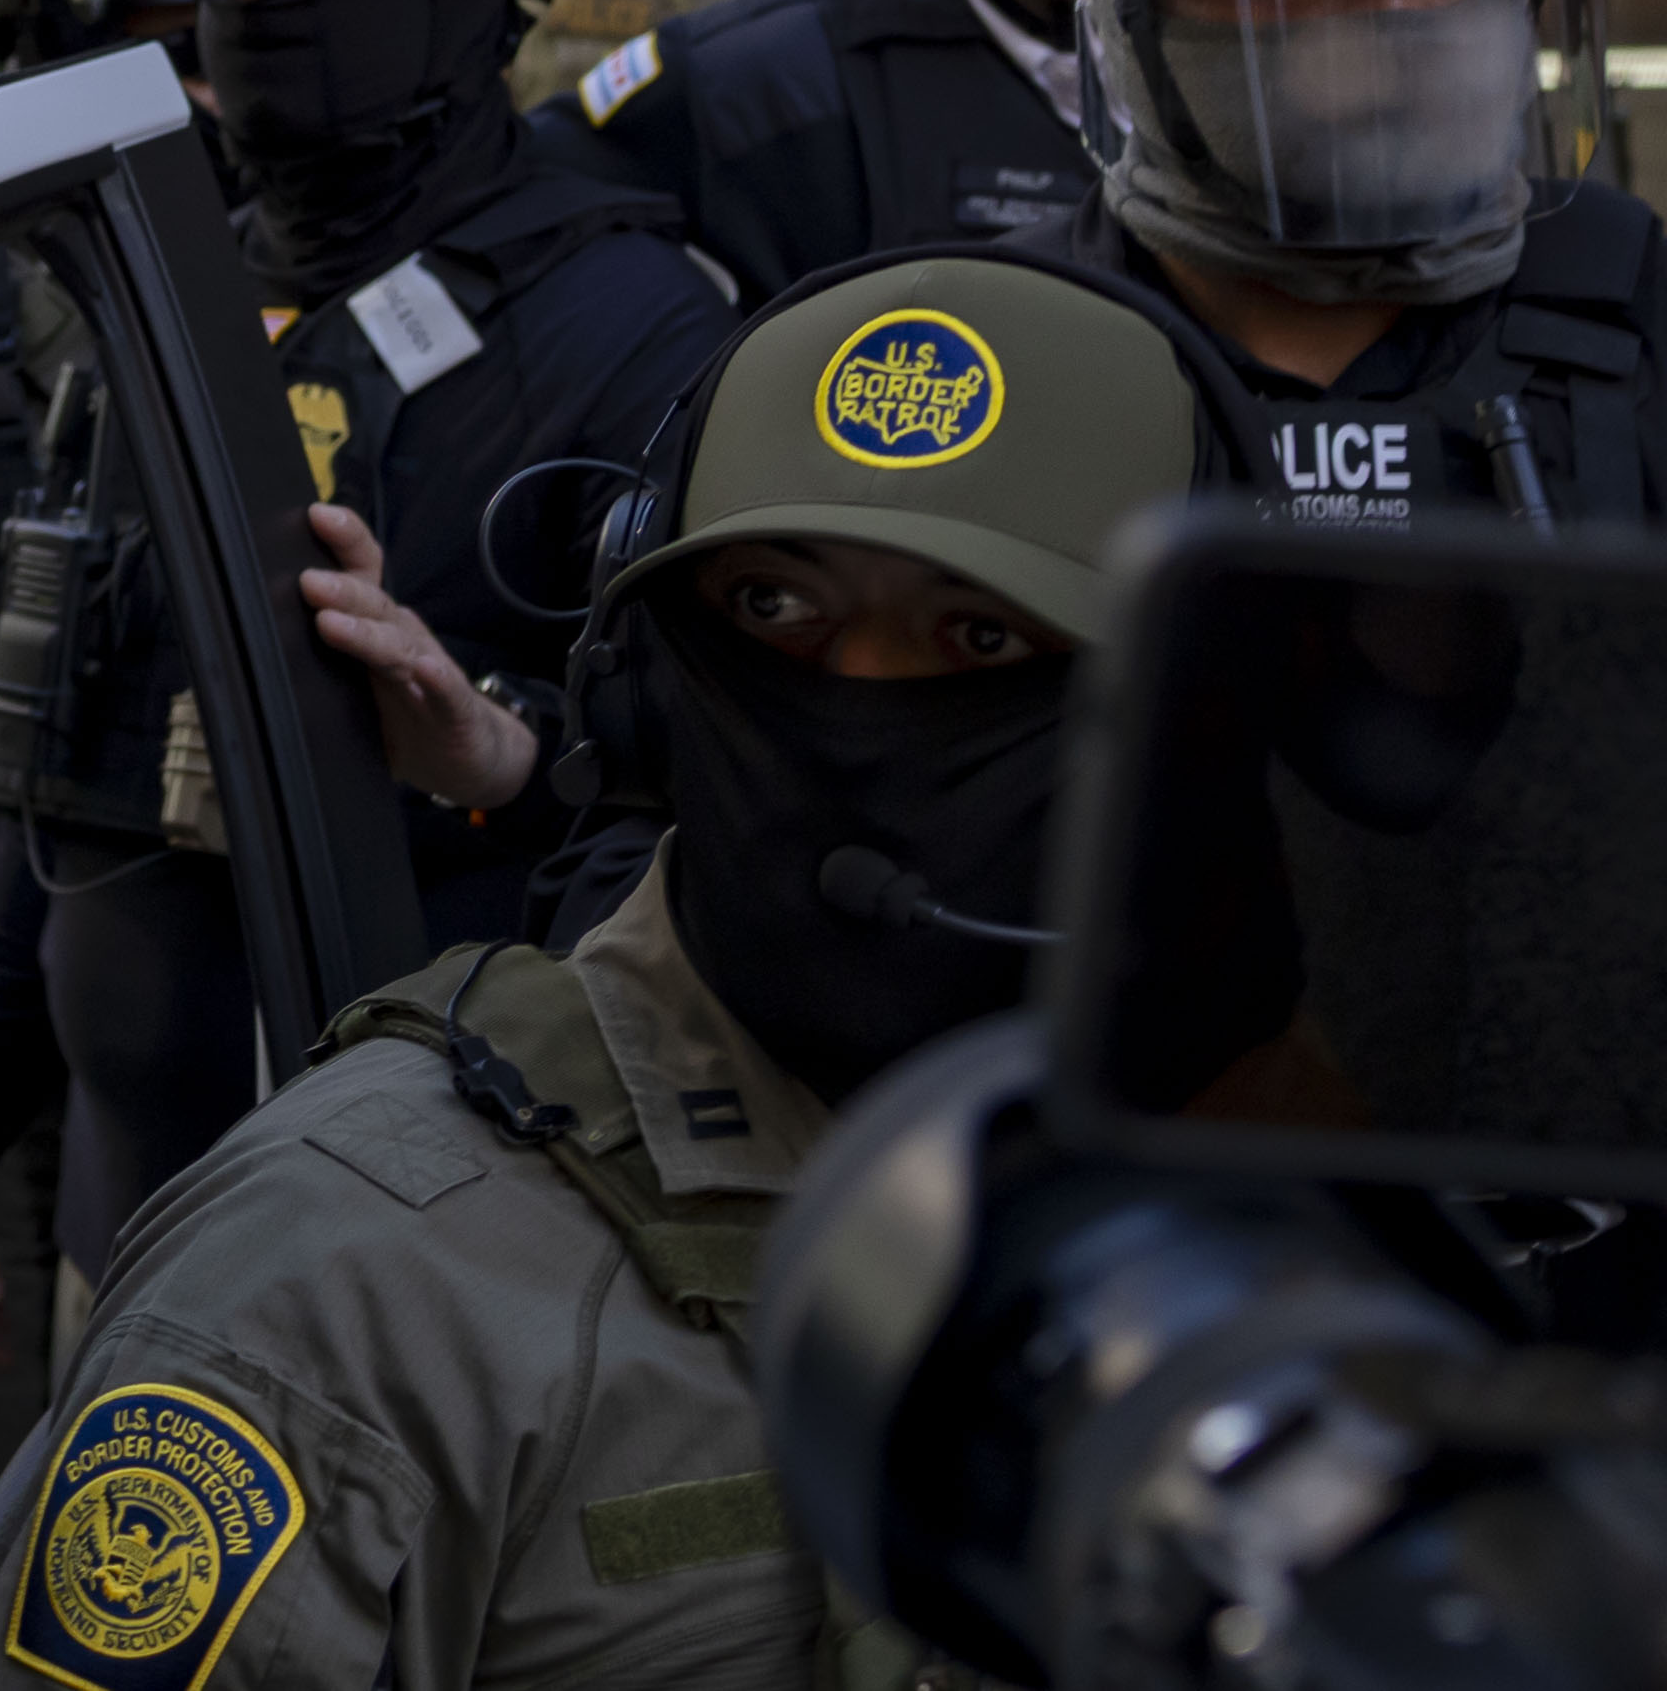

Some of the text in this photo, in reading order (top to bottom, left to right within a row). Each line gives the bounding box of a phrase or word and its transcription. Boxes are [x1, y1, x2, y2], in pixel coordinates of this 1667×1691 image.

[886, 341, 943, 371] U.S.
[837, 400, 961, 434] PATROL
[843, 373, 969, 409] BORDER
[1271, 422, 1411, 490] LICE
[1363, 498, 1411, 520] AND
[114, 1407, 275, 1527] U.S. CUSTOMS AND
[66, 1435, 252, 1555] BORDER PROTECTION
[107, 1476, 208, 1550] DEPARTMENT
[194, 1554, 212, 1585] OF
[103, 1598, 201, 1651] SECURITY
